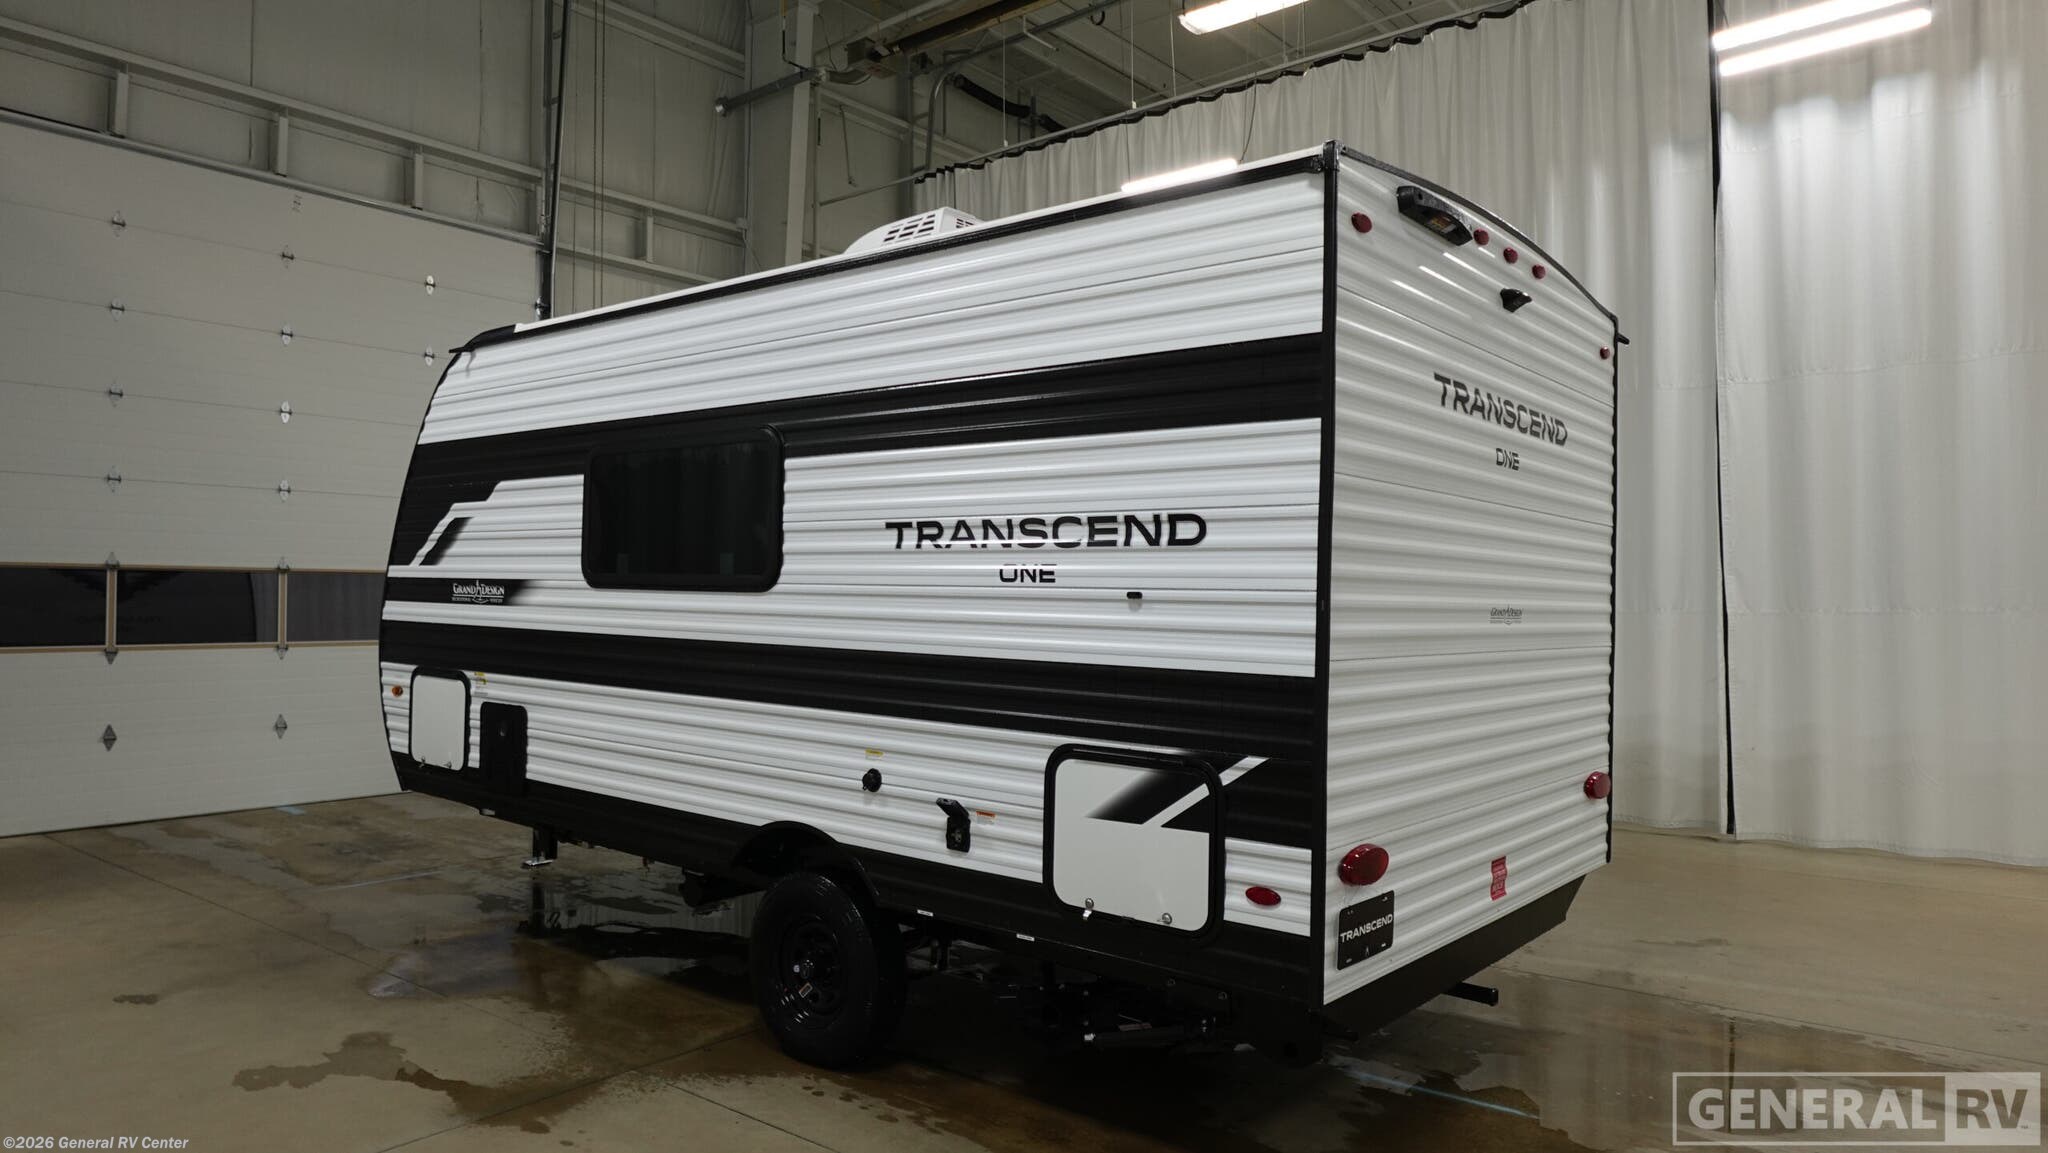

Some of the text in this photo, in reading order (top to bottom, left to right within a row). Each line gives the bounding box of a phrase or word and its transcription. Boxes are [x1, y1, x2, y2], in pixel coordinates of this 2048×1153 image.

[1434, 372, 1568, 446] TRANSCEND
[1496, 448, 1520, 471] ONE
[885, 513, 1207, 550] TRANSCEND
[999, 563, 1057, 584] ONE
[1339, 913, 1394, 943] TRANSCEND
